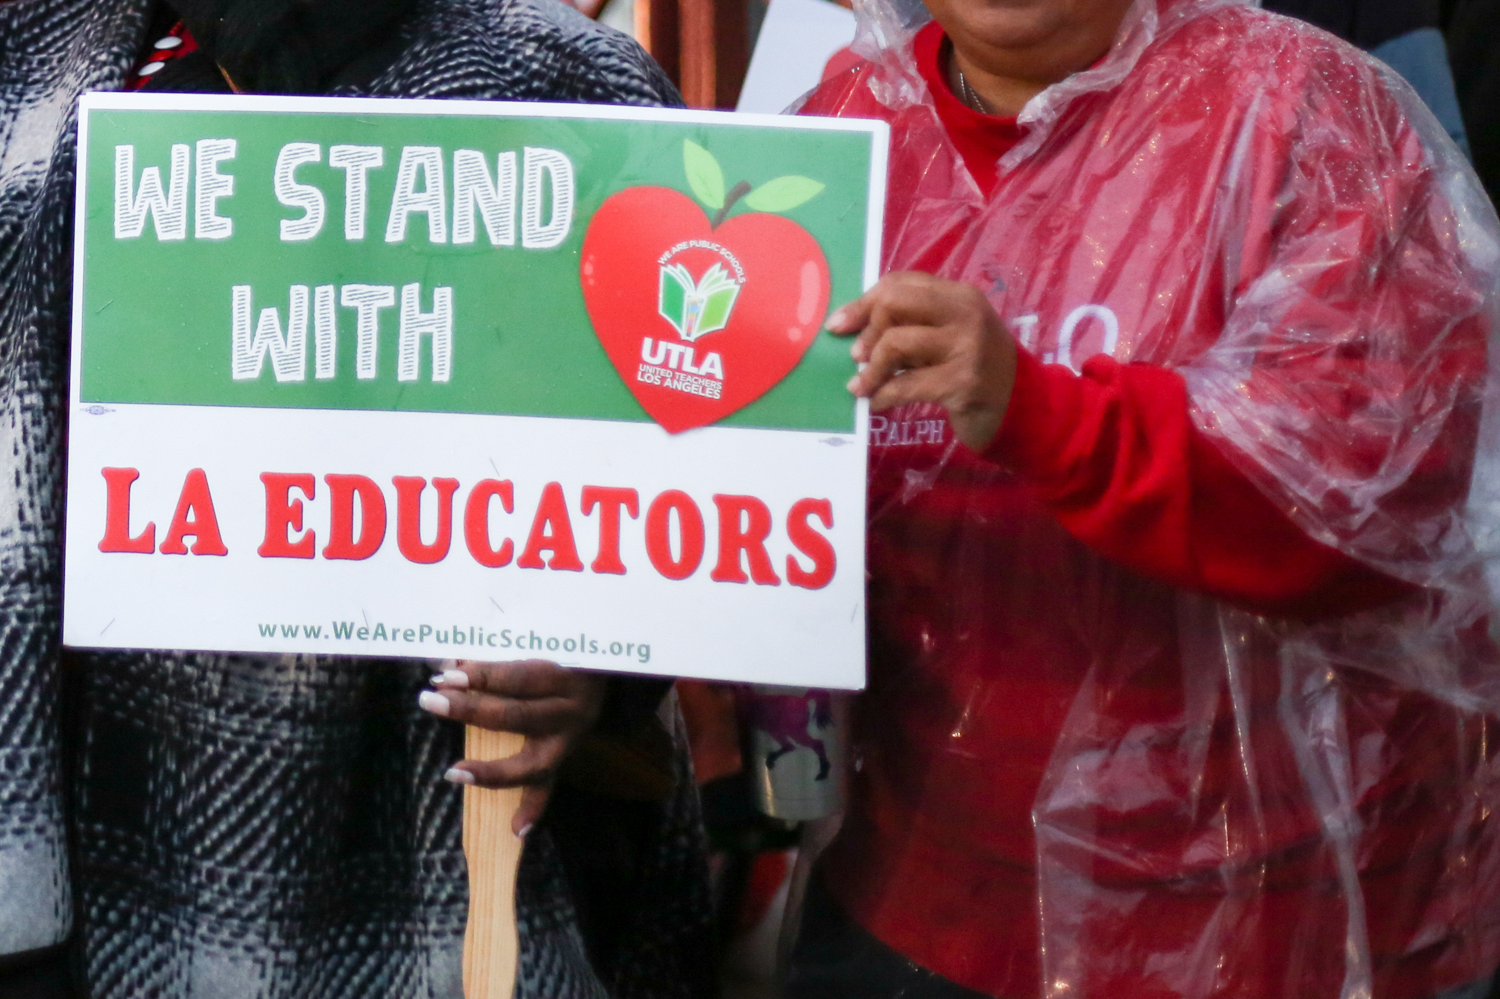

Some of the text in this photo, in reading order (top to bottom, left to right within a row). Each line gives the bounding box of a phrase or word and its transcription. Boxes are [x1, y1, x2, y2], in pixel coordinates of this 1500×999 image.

[114, 138, 574, 249] WE STAND
[657, 239, 746, 284] WE ARE PUBLIC SCHOOLS
[231, 285, 452, 382] WITH
[638, 363, 723, 390] UNITED TEACHERS
[641, 336, 724, 380] UTLA
[636, 371, 722, 400] LOS ANGELES
[867, 415, 946, 446] RALPH
[98, 466, 838, 590] LA EDUCATORS
[257, 621, 651, 663] www.WeArePublicSchools.org
